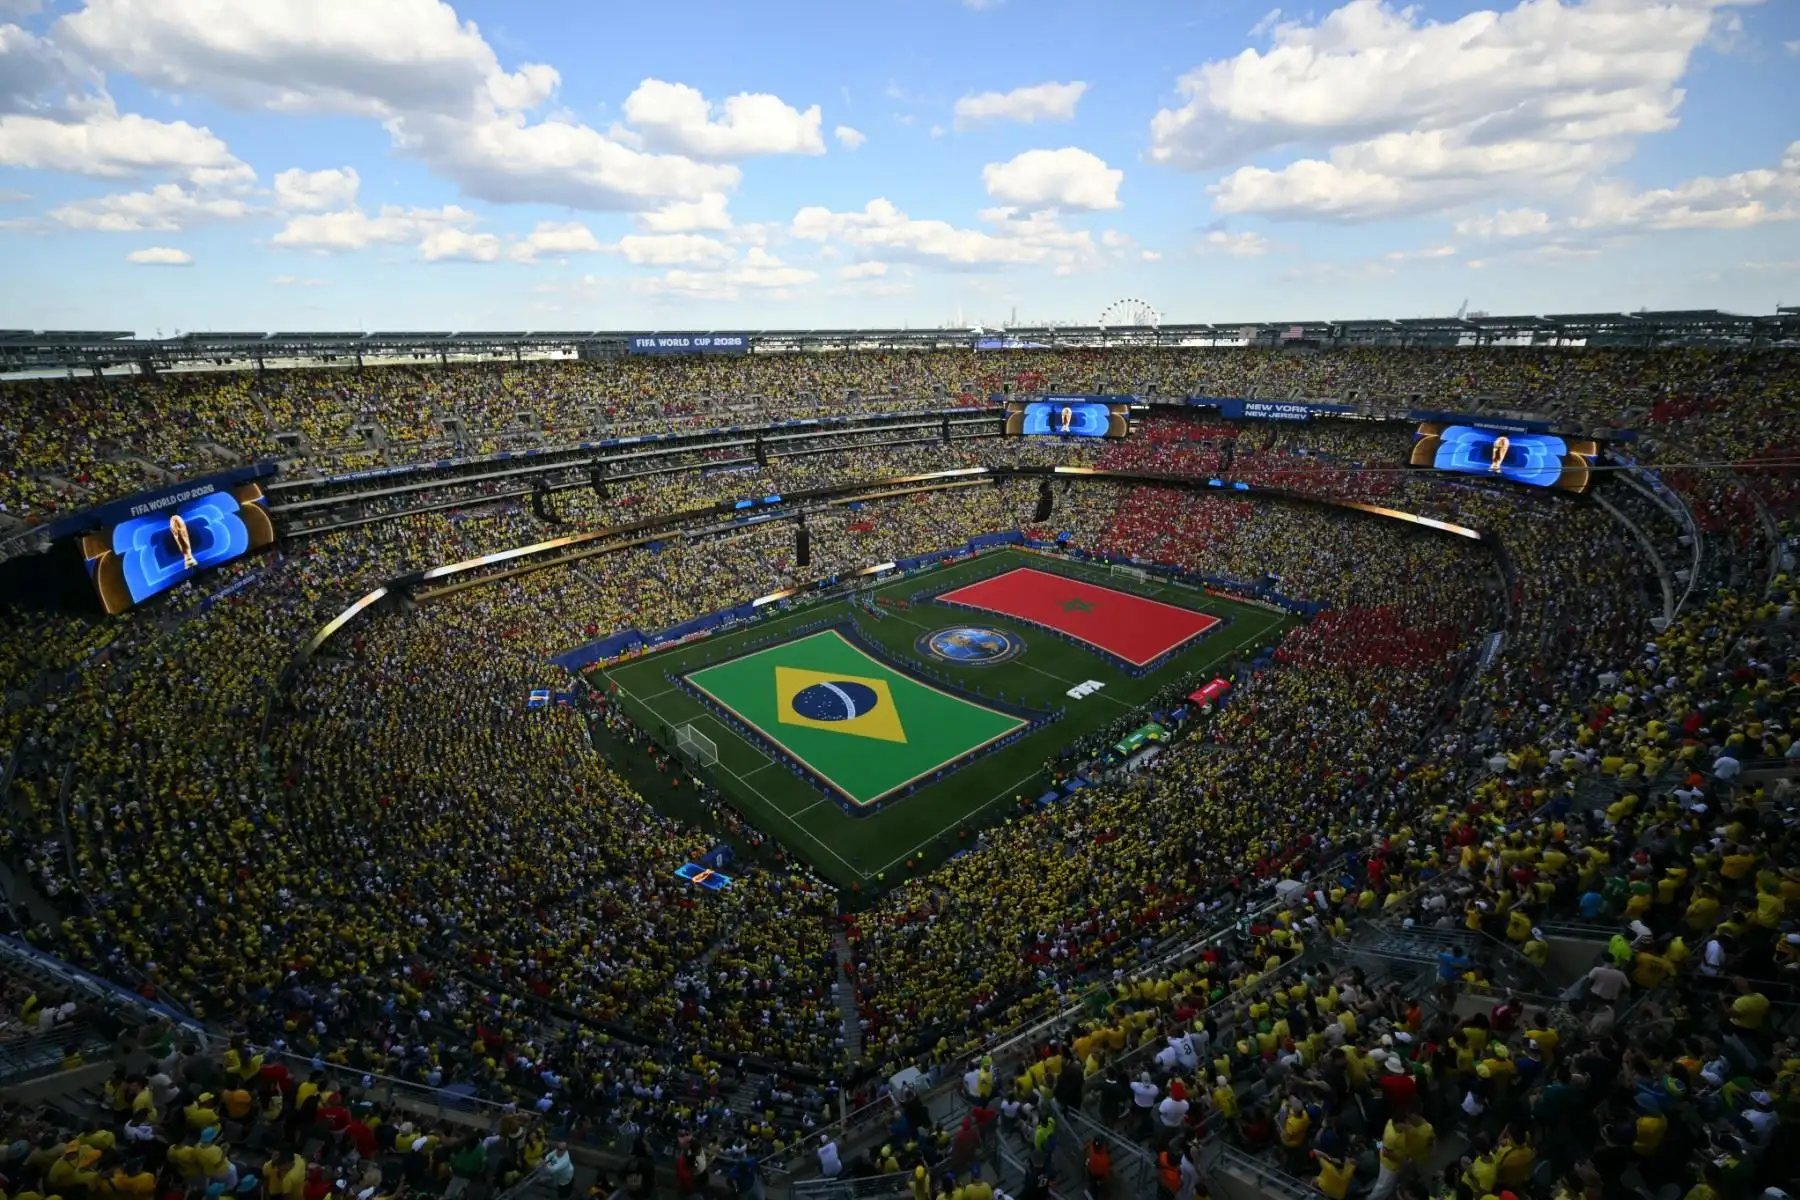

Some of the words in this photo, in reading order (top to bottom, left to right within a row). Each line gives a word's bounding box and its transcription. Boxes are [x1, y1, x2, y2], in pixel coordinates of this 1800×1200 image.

[636, 339, 656, 347] FIFA
[659, 338, 690, 347] WORLD
[694, 338, 711, 346] CUP
[713, 337, 742, 346] 2026
[1245, 403, 1273, 411] NEW
[1275, 404, 1308, 413] YORK
[1268, 412, 1308, 420] JERSEY
[130, 503, 150, 516] FIFA
[148, 495, 177, 511] WORLD
[176, 491, 191, 502] CUP
[190, 483, 215, 498] 2026
[1066, 679, 1106, 700] FIFA
